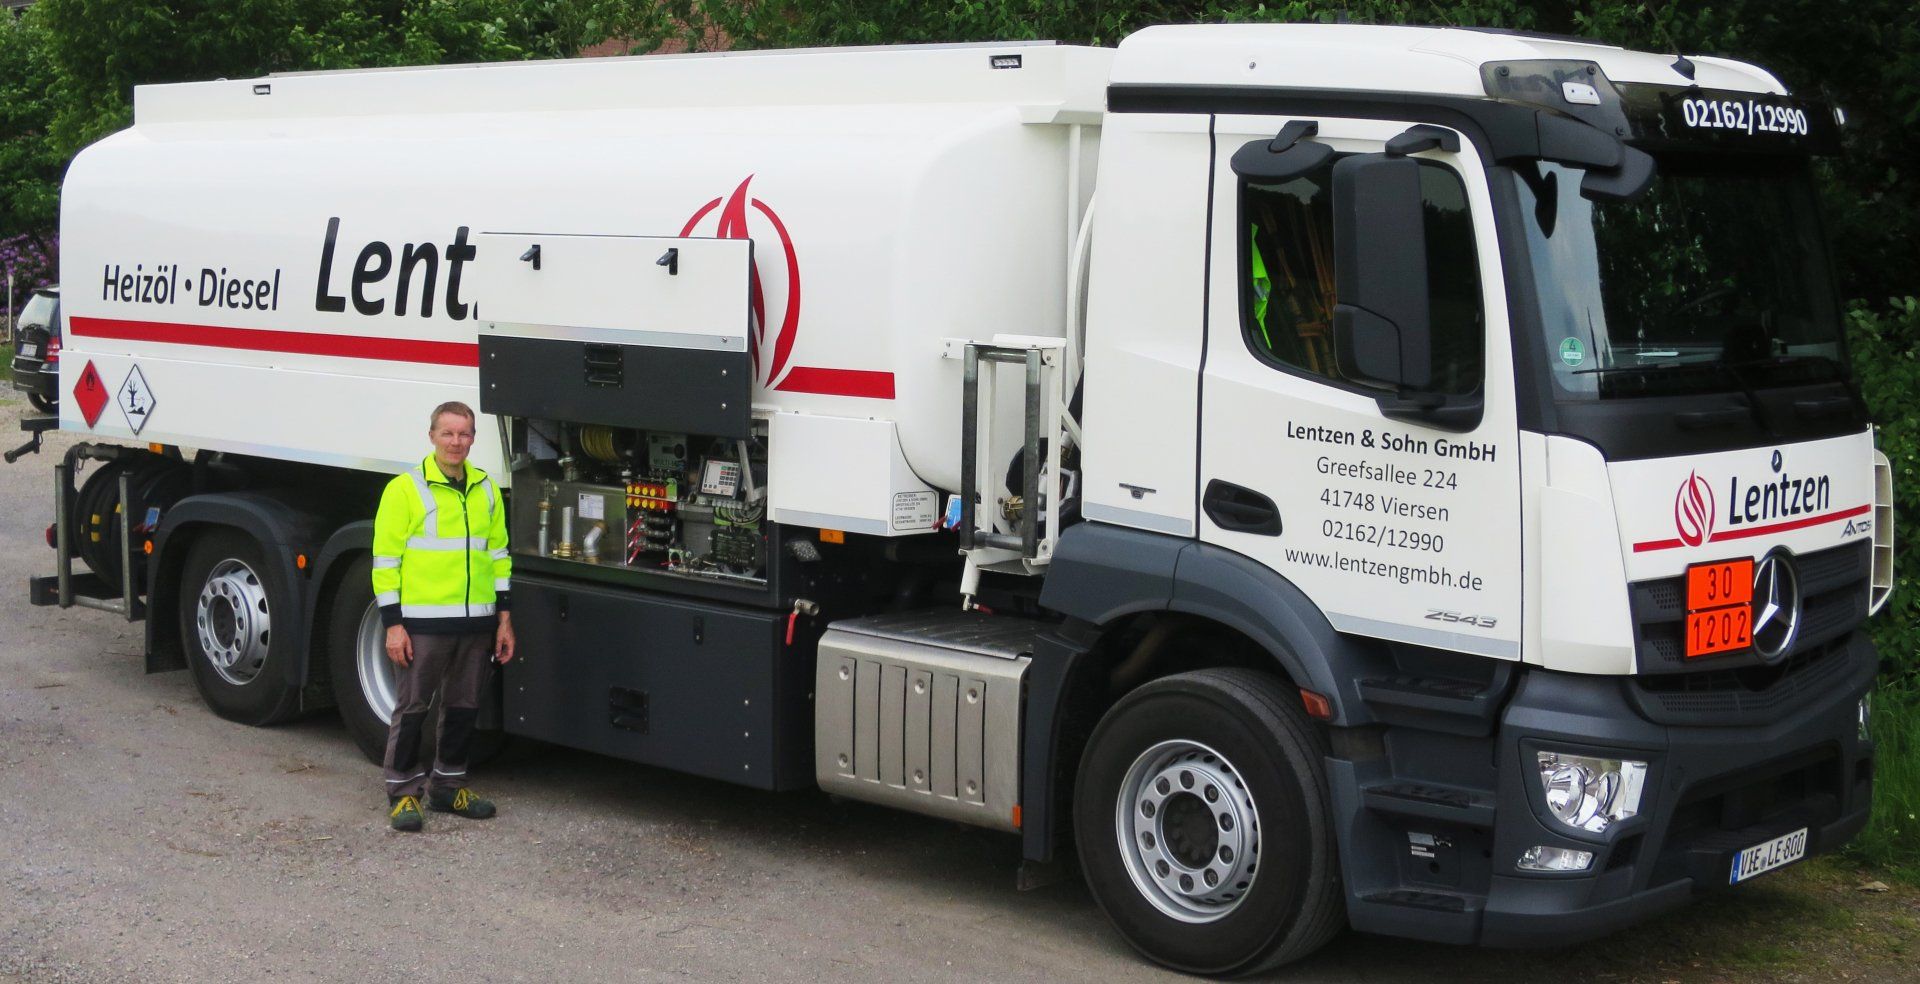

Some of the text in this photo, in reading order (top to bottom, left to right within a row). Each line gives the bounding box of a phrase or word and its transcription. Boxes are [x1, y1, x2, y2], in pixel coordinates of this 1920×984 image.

[1682, 99, 1807, 135] 02162/12990
[315, 216, 478, 321] Lent
[103, 264, 280, 311] Heizöl Diesel
[1287, 421, 1496, 462] Lentzen & Sohn GmbH
[1316, 456, 1458, 490] Greefsallee 224
[1320, 488, 1449, 522] 41748 Viersen
[1729, 473, 1829, 525] Lentzen
[1322, 519, 1444, 553] 02162/12990
[1285, 549, 1483, 591] www.lentzengmbh.de
[1708, 566, 1732, 600] 30
[1424, 609, 1498, 629] 2543
[1693, 610, 1747, 651] 1202
[1741, 847, 1762, 876] VIE
[1767, 840, 1783, 866] LE
